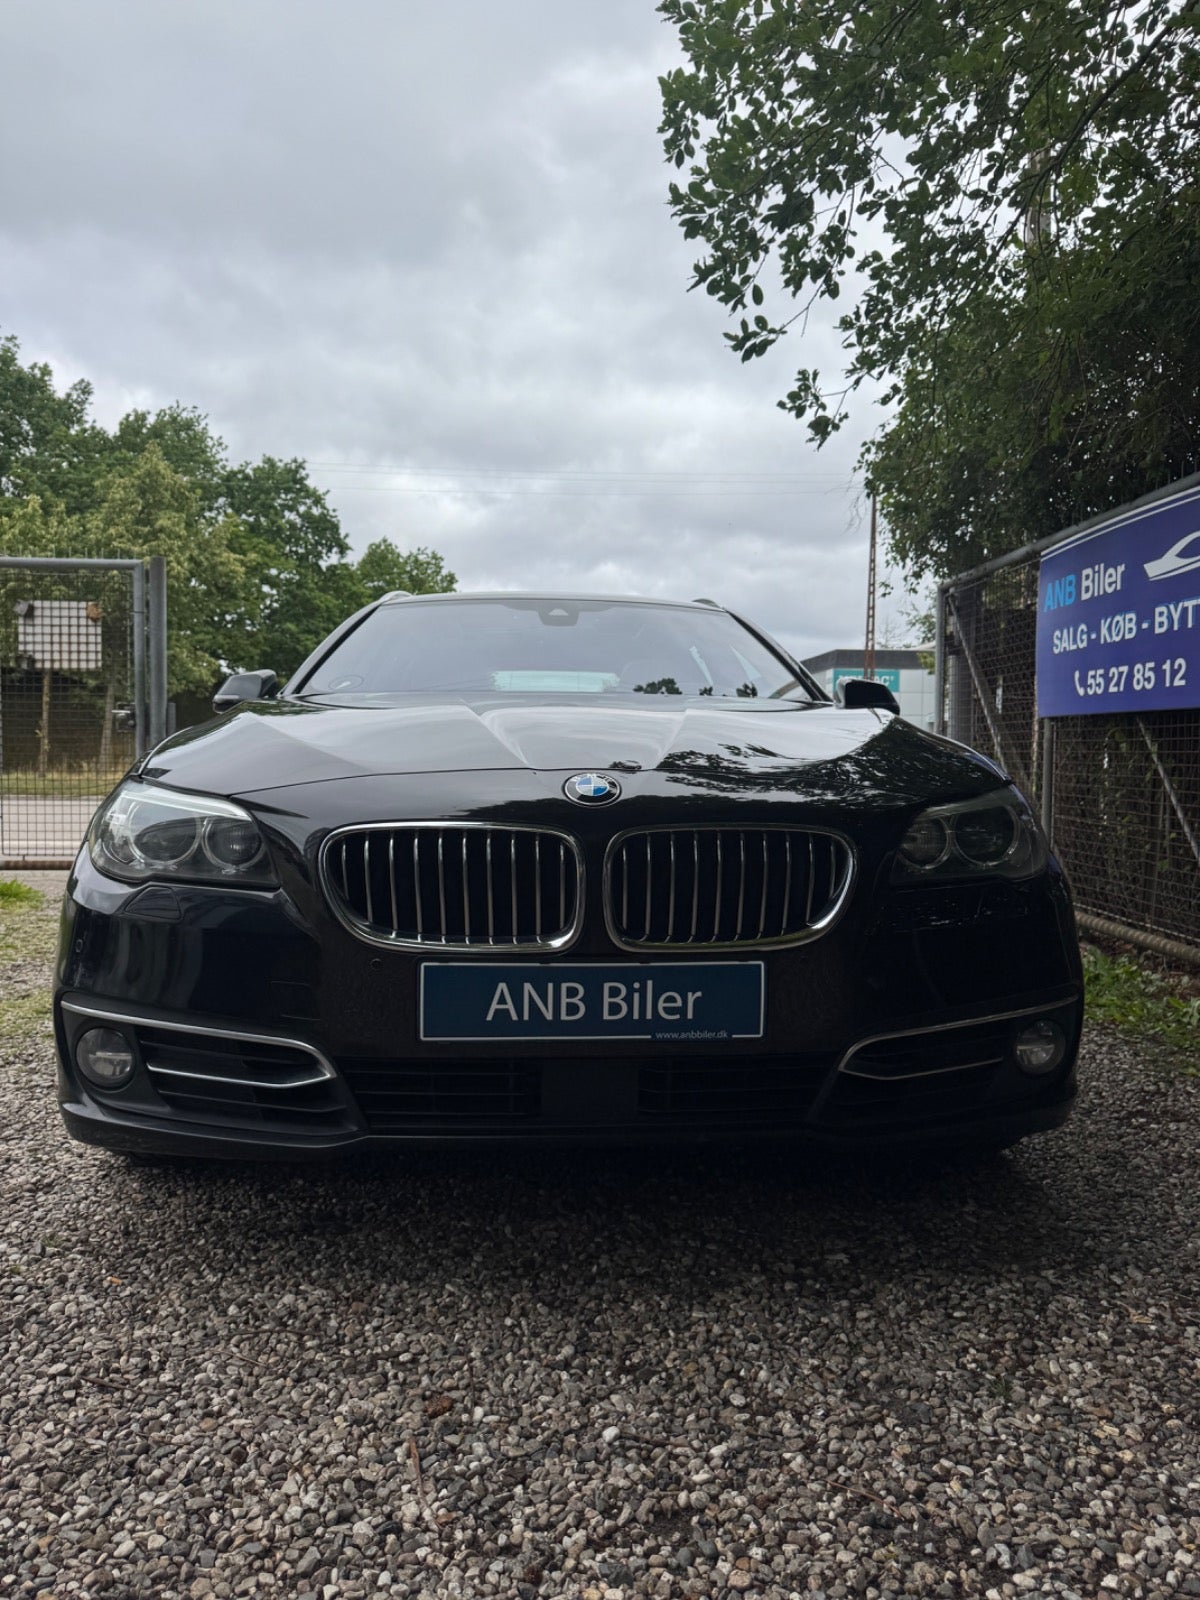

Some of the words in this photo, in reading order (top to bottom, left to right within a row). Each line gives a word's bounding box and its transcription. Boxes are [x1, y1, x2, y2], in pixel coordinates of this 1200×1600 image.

[1044, 574, 1076, 612] ANB
[1081, 563, 1125, 601] Biler
[1053, 623, 1087, 654] SALG
[1100, 612, 1137, 644] KØB
[1154, 598, 1200, 634] BYT
[1087, 669, 1105, 695] 55
[1108, 665, 1129, 693] 27
[1132, 662, 1155, 691] 85
[1162, 658, 1187, 688] 12
[485, 982, 586, 1021] ANB
[602, 980, 702, 1020] Biler
[655, 1030, 728, 1039] www.anbbiler.dk
